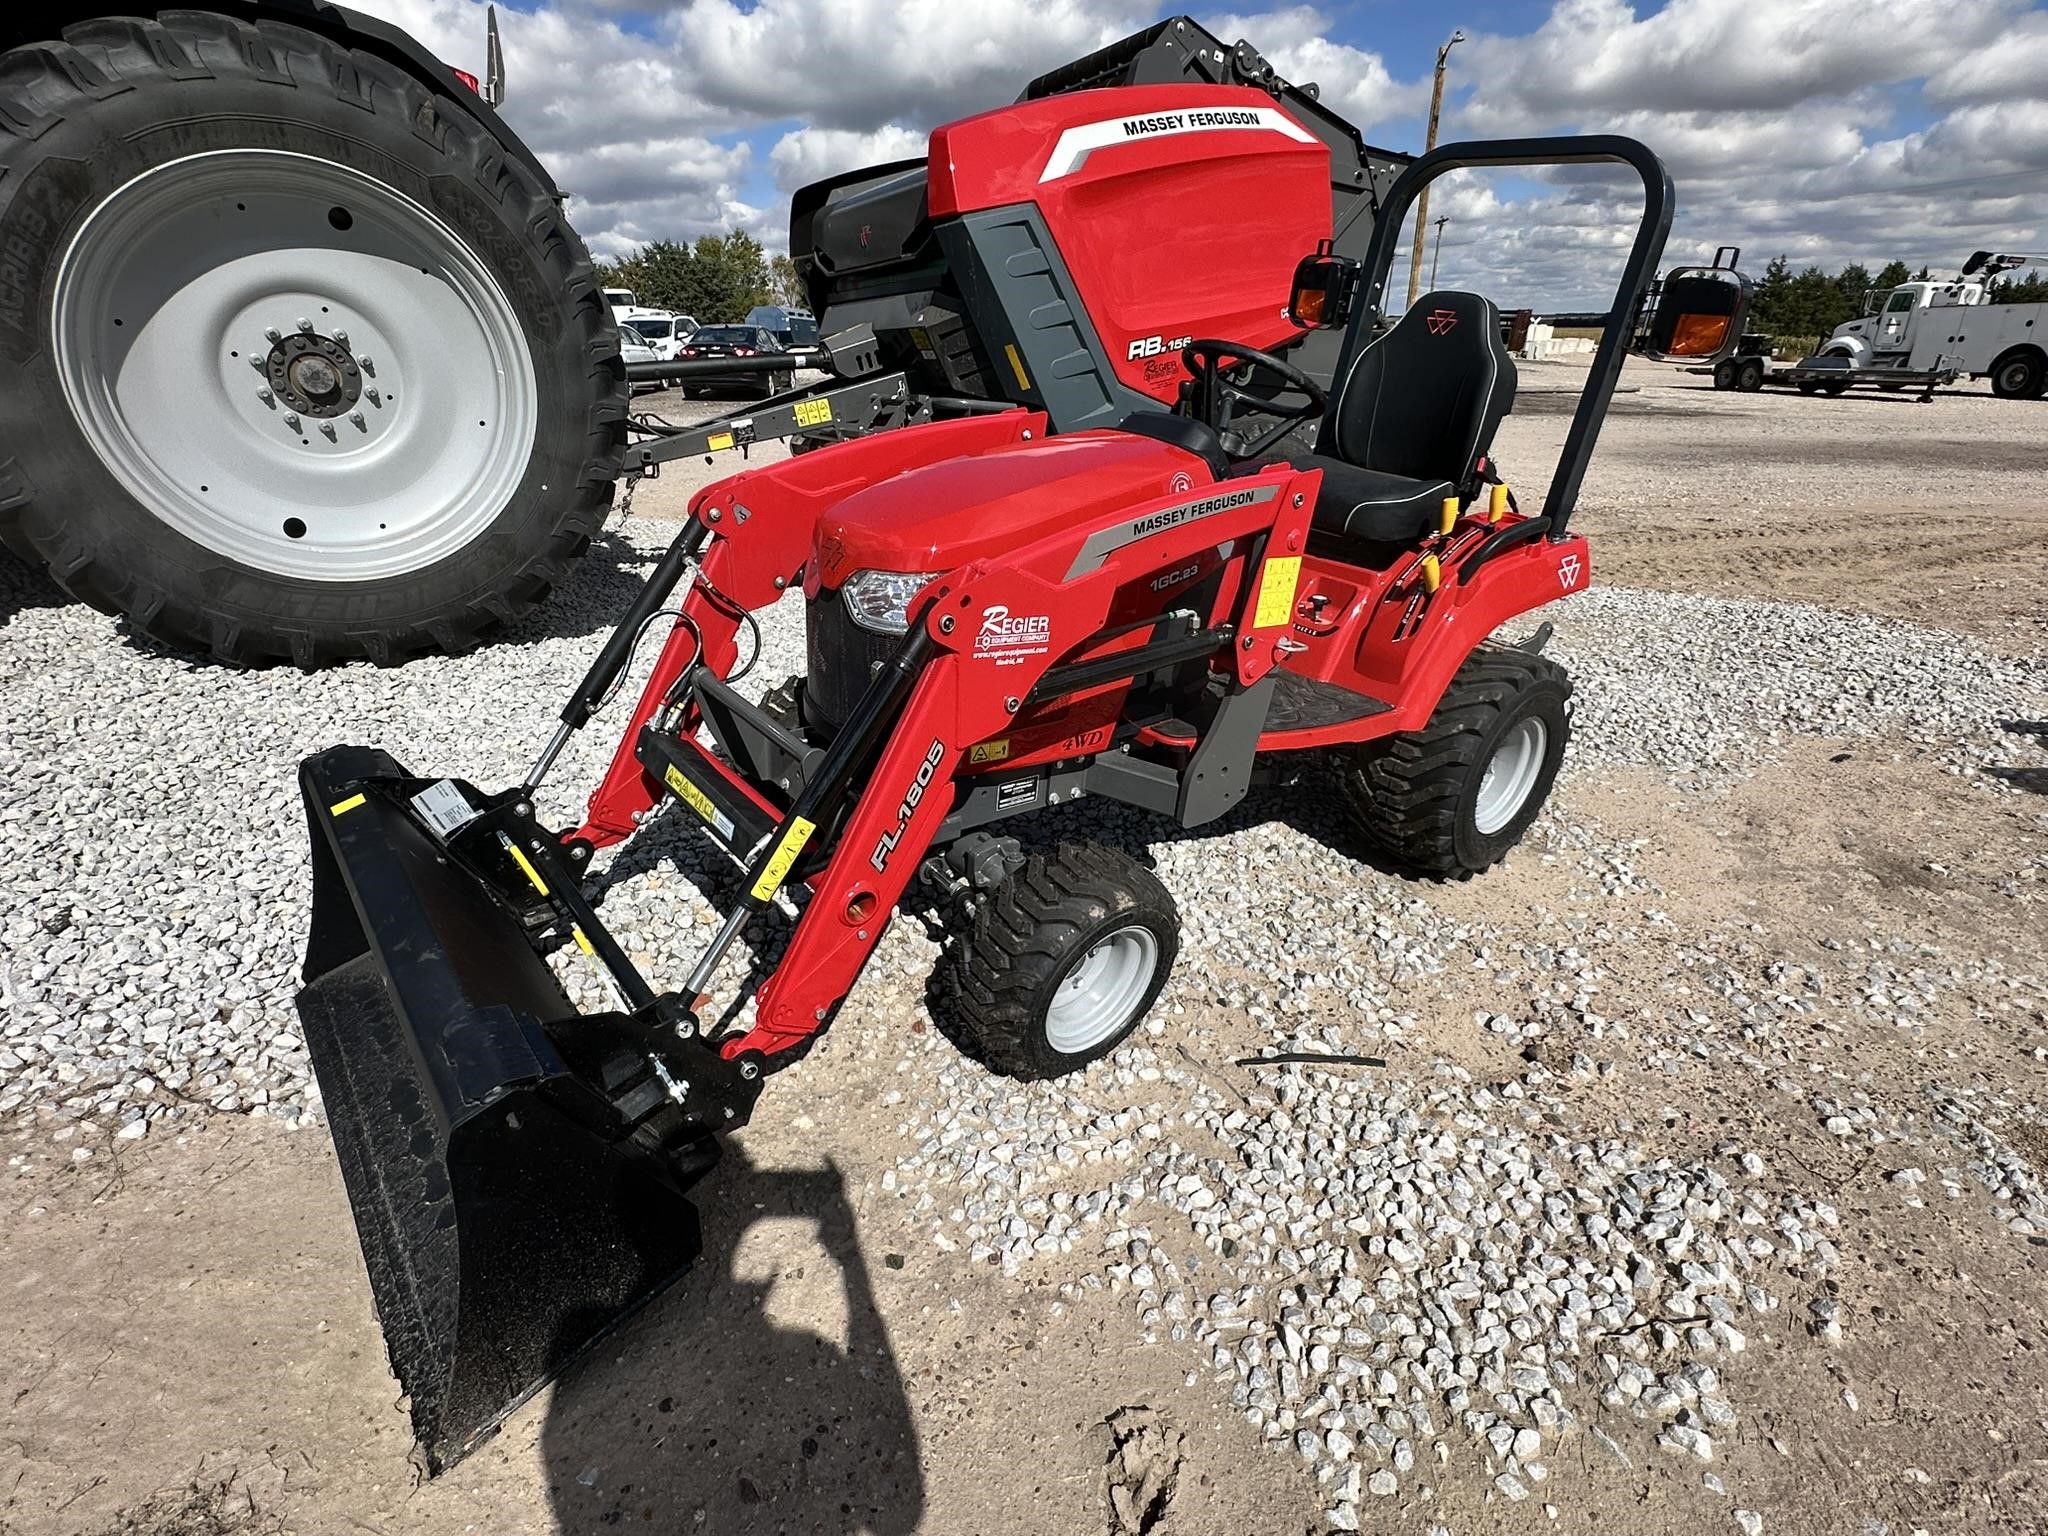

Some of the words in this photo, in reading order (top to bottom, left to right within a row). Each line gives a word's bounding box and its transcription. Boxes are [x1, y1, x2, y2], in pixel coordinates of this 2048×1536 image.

[1123, 115, 1183, 136] MASSEY
[1188, 112, 1260, 127] FERGUSON
[1133, 508, 1187, 536] MASSEY
[1190, 490, 1255, 518] FERGUSON
[1150, 564, 1199, 592] 1GC.23
[979, 605, 1050, 635] REGIER
[1061, 730, 1104, 751] 4WD
